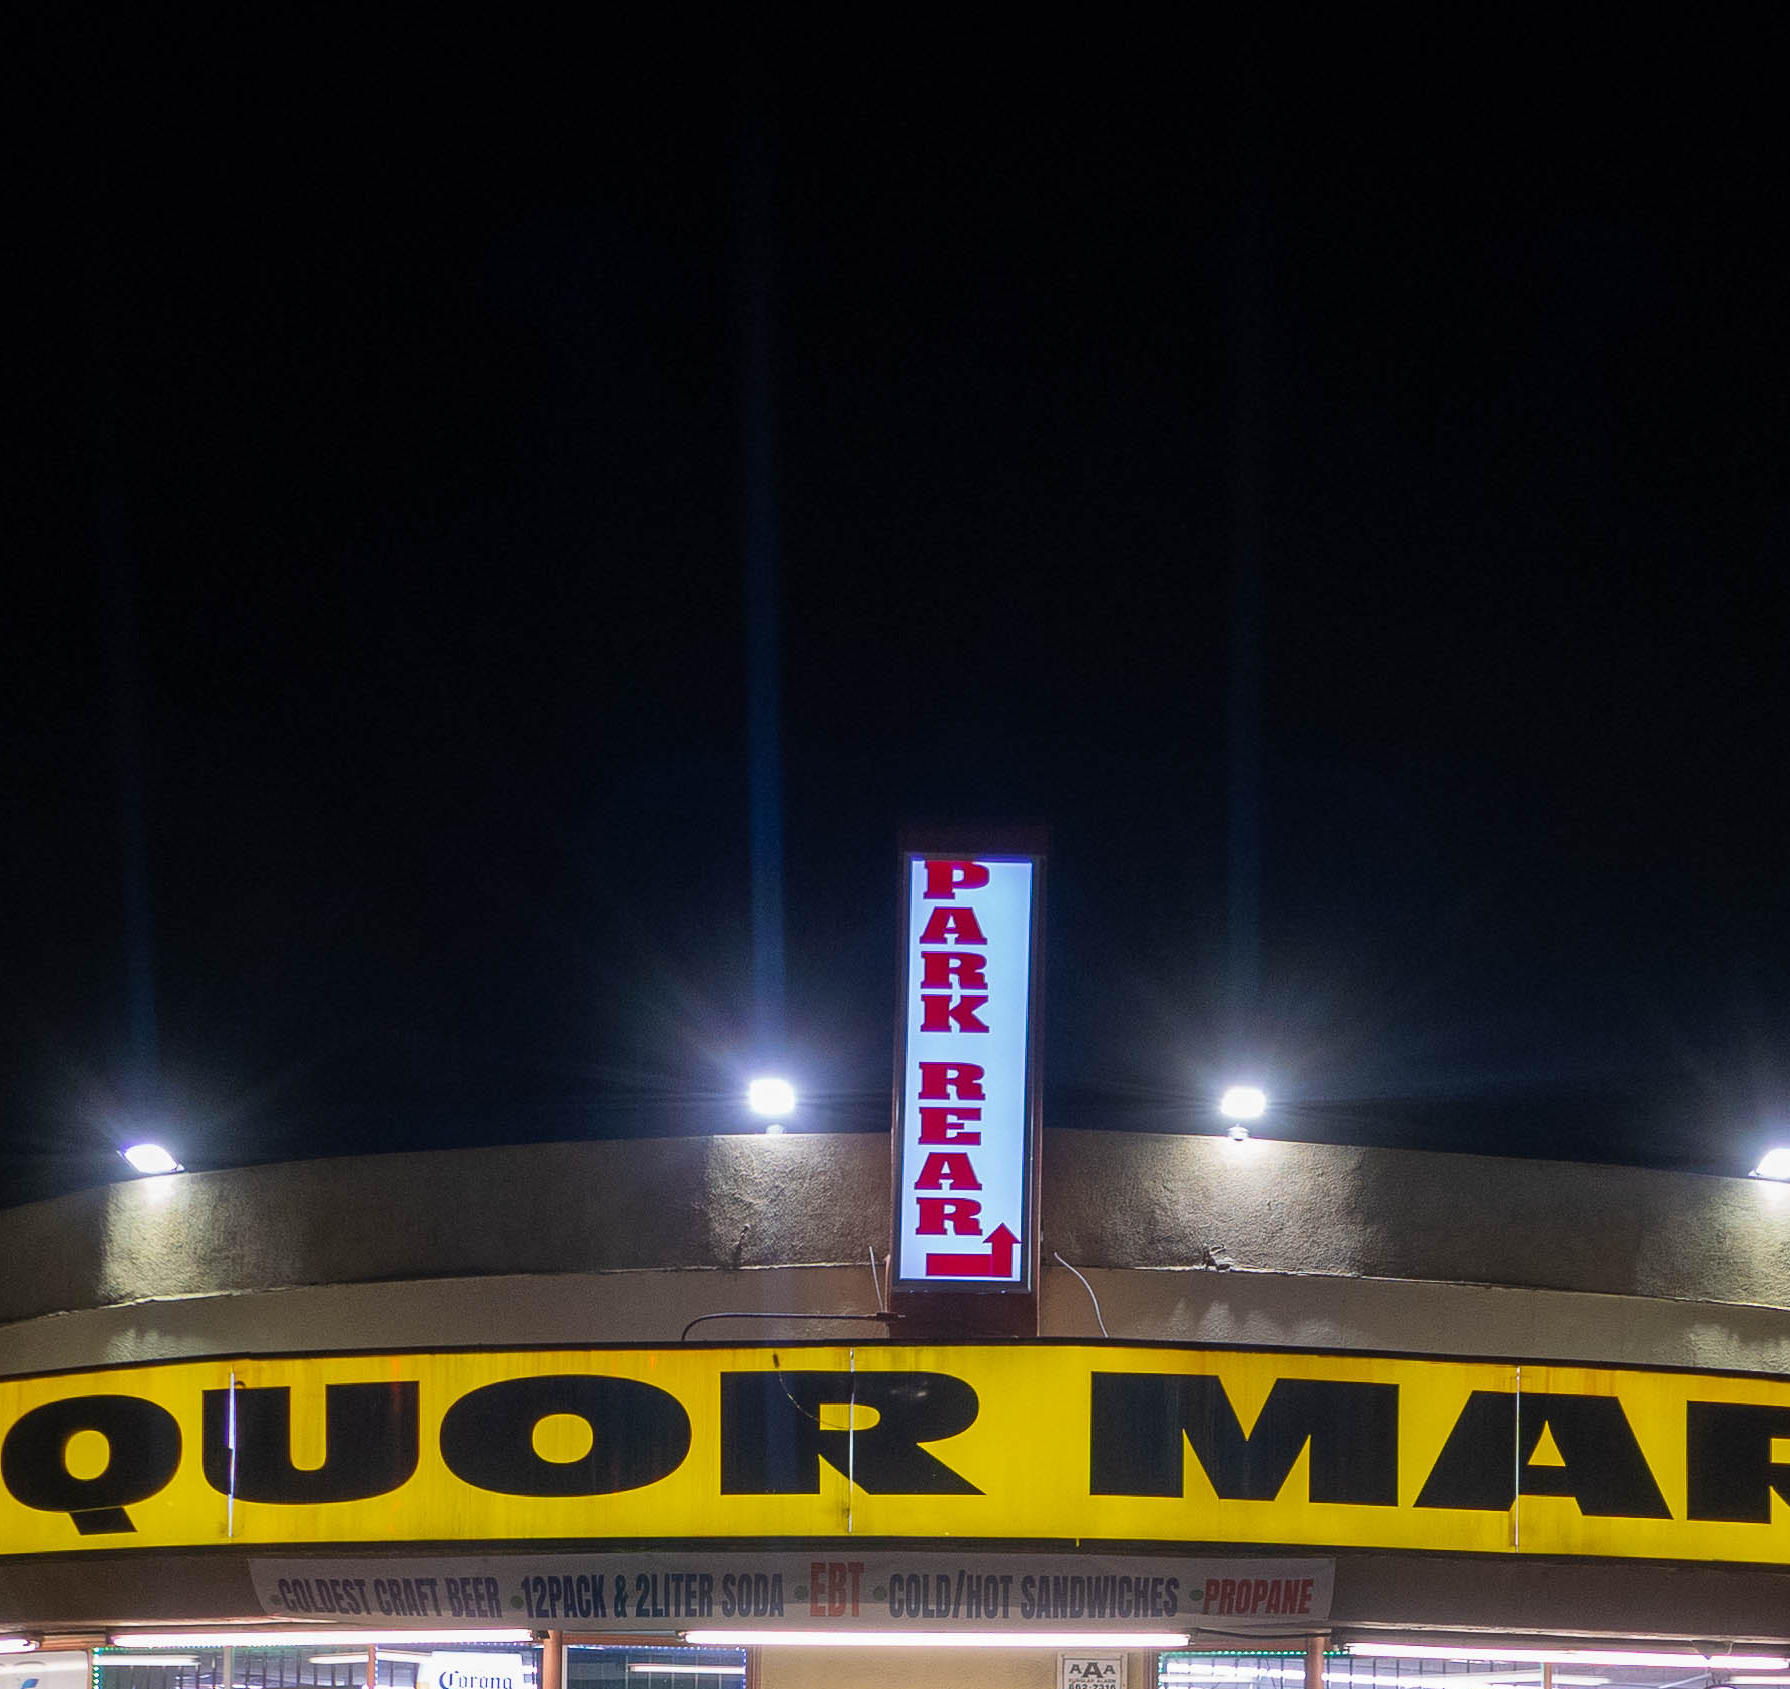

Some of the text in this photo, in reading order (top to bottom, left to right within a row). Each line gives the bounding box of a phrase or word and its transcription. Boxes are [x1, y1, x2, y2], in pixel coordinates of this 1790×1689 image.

[914, 860, 990, 1236] PARK REAR
[277, 1561, 1313, 1619] COLDEST CRAFT BEER 12PACK & 2LITER SODA EBT COLD/HOT SANDWICHES PROPANE
